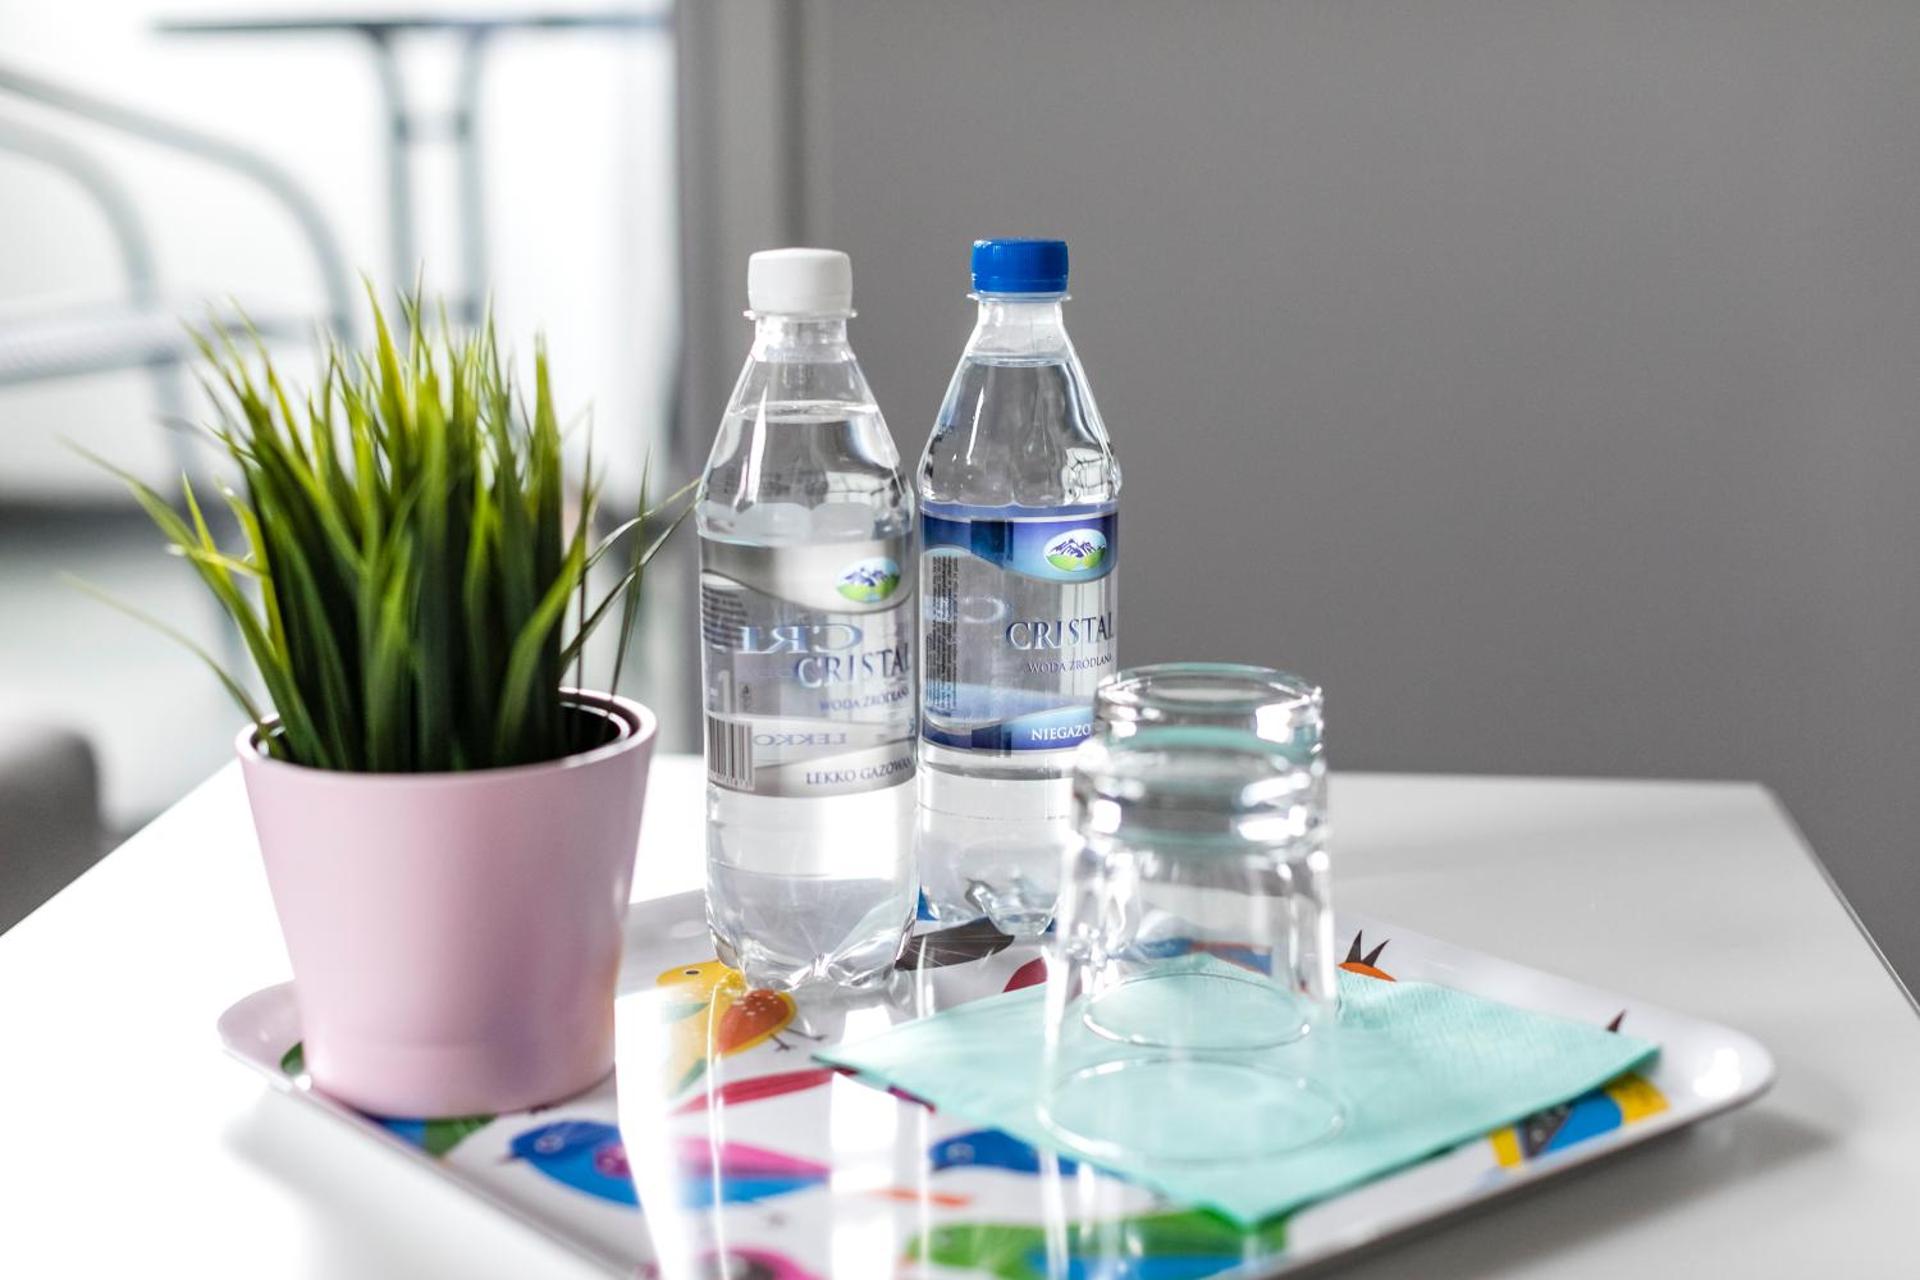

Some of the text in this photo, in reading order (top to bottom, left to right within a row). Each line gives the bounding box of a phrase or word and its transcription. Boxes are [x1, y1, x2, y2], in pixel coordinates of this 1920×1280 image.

[1005, 612, 1114, 651] CRISTAL
[792, 643, 910, 688] CRISTAL
[1024, 661, 1066, 673] WODA
[1031, 723, 1091, 741] NIEGAZO
[806, 769, 857, 785] LEKKO
